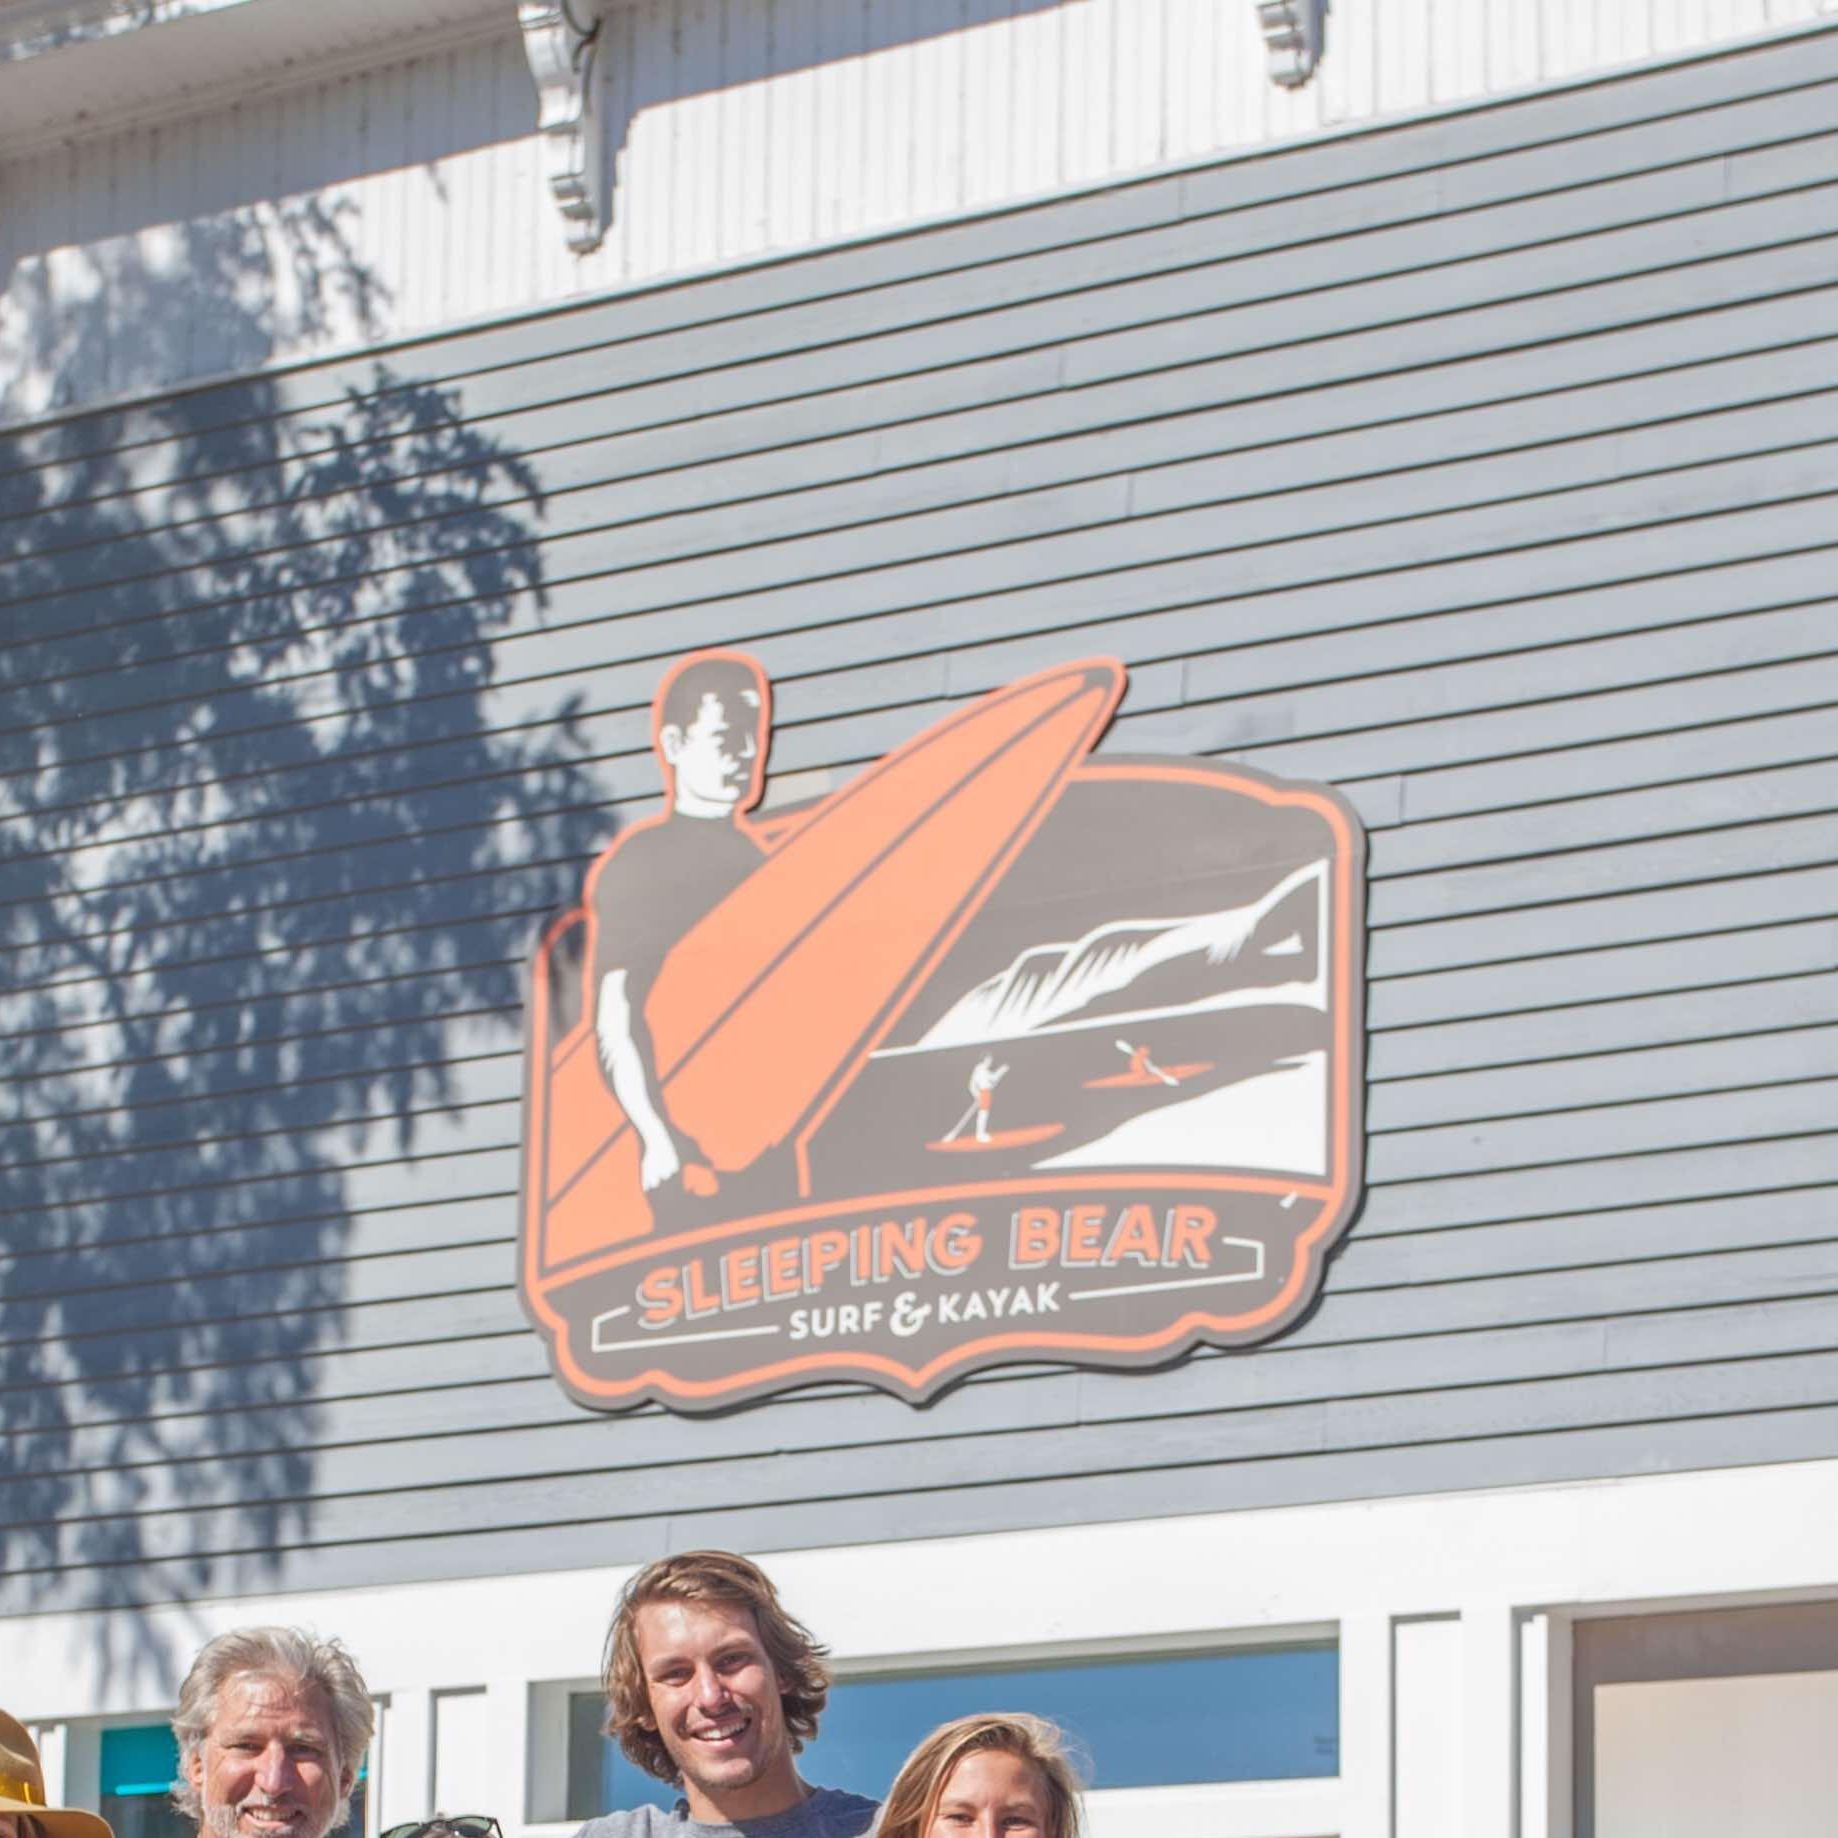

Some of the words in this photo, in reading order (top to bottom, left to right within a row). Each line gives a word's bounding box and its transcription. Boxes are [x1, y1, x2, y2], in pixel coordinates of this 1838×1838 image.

[634, 1211, 984, 1330] SLEEPING
[1007, 1202, 1219, 1270] BEAR
[788, 1301, 884, 1341] SURF
[888, 1290, 933, 1337] &
[937, 1281, 1062, 1325] KAYAK
